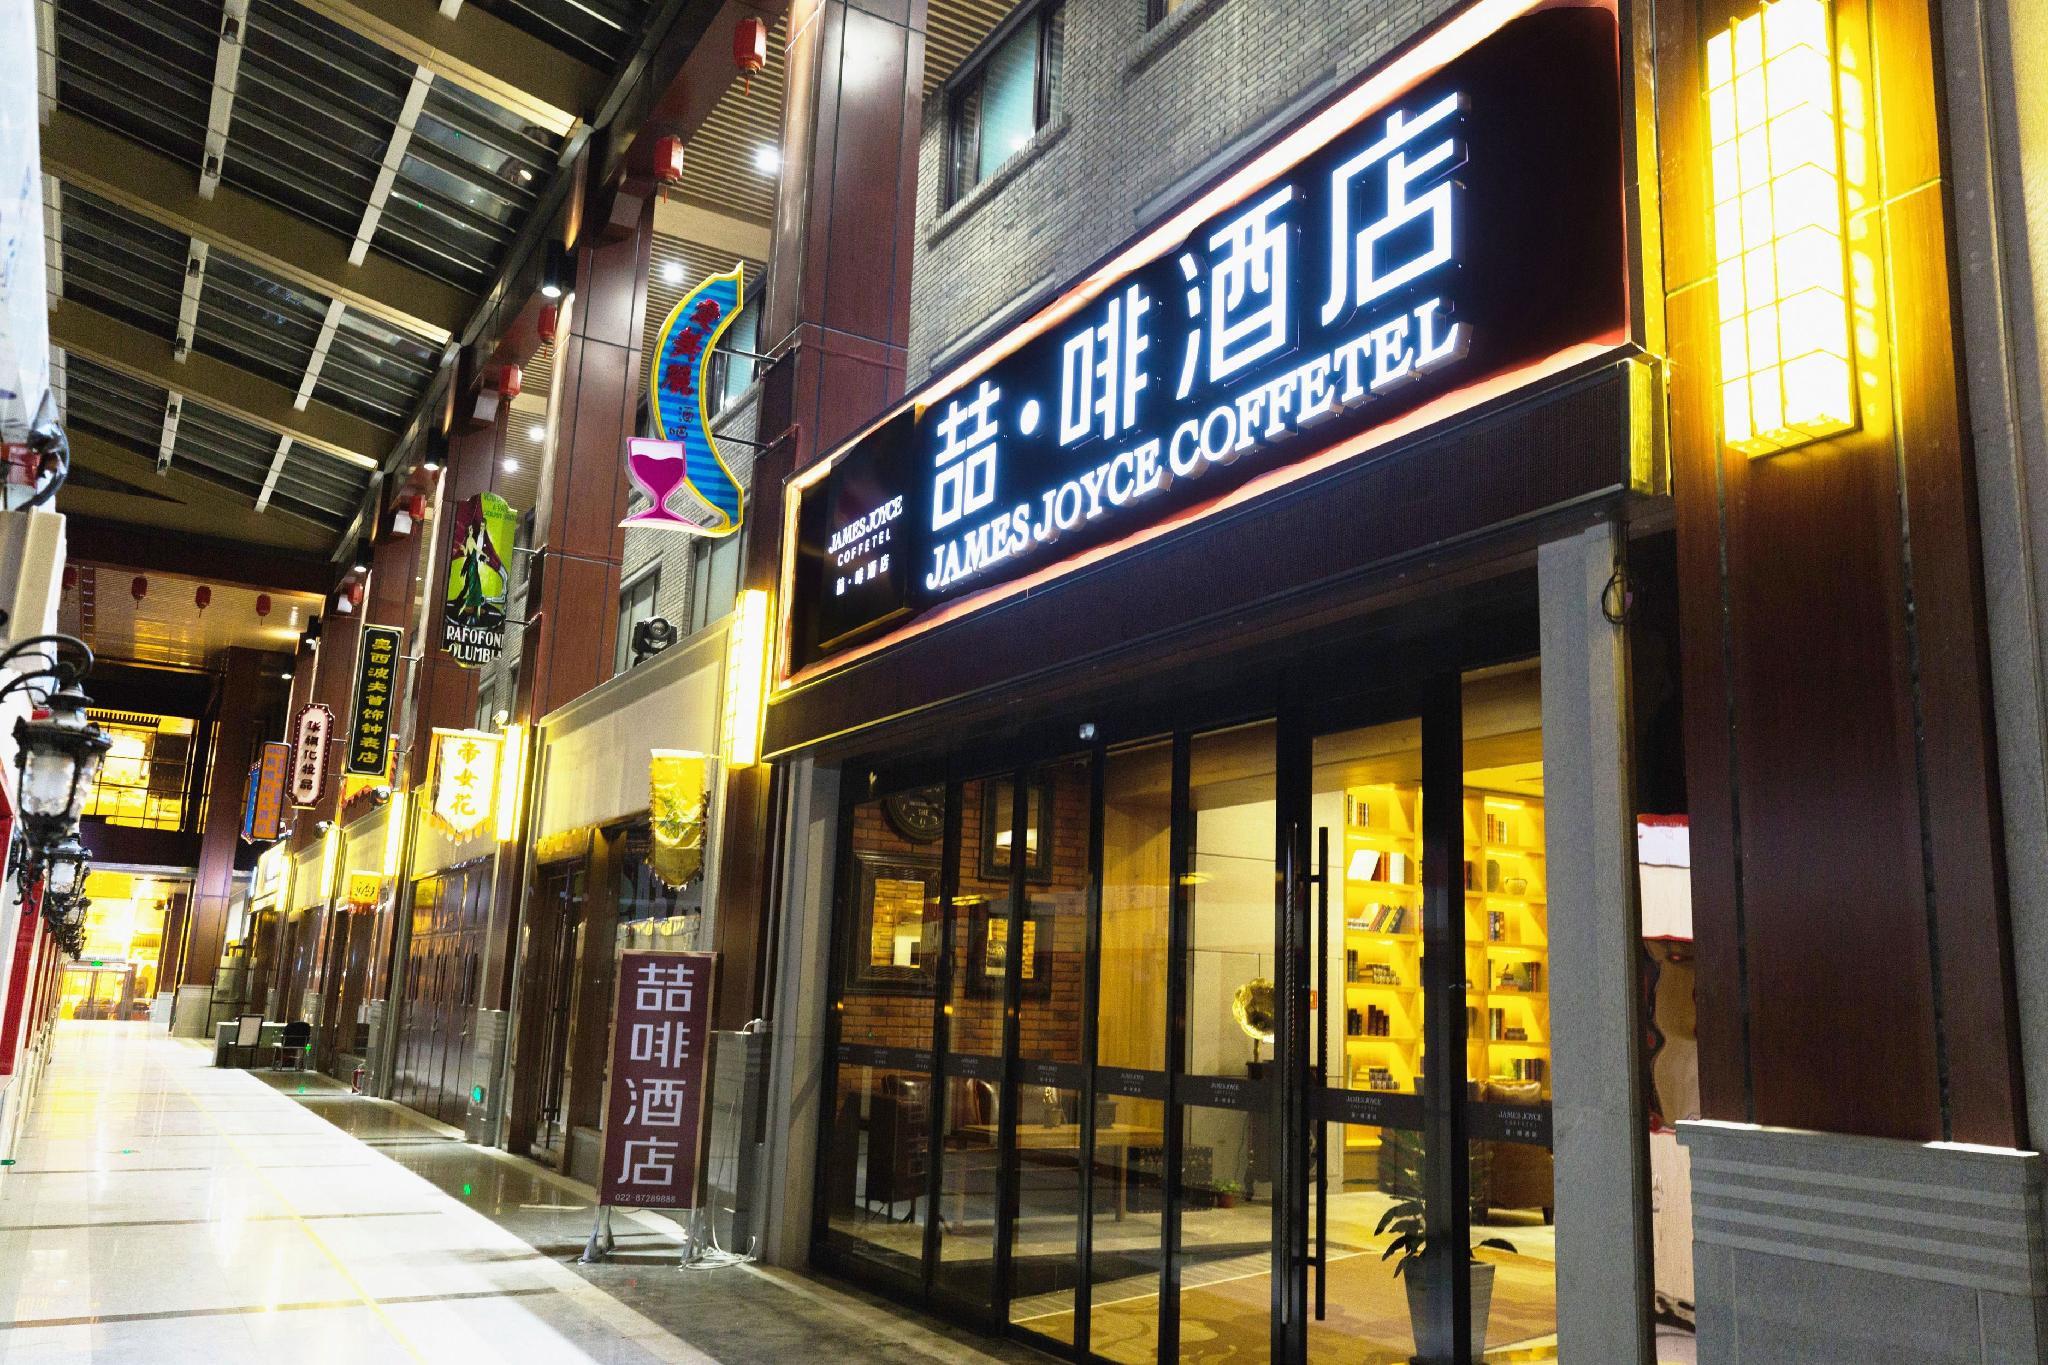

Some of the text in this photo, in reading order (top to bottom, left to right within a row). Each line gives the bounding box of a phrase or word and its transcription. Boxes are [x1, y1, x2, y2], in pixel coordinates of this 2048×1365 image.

[925, 297, 1460, 590] JAMES JOYCE COFFETEL
[828, 495, 903, 554] JAMES JOYCE
[837, 528, 891, 567] COFFETEL
